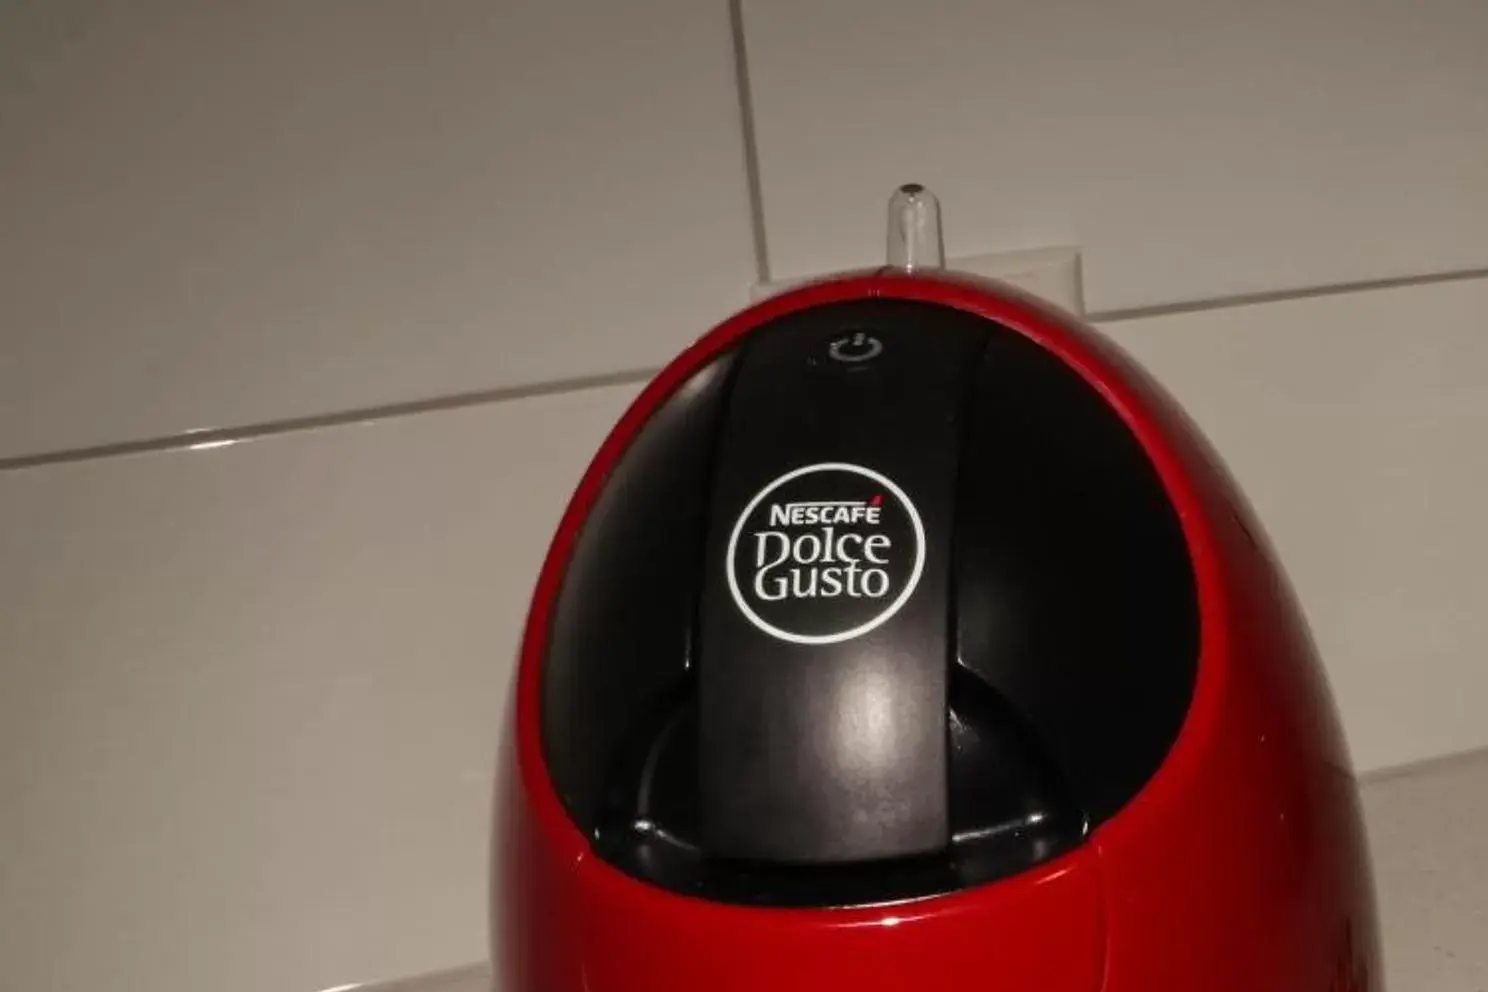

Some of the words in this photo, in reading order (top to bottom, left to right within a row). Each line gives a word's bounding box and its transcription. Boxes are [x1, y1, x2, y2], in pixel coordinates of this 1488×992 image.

[769, 494, 886, 527] NESCAFÉ
[754, 527, 892, 566] Dolce
[754, 561, 891, 601] Gusto
